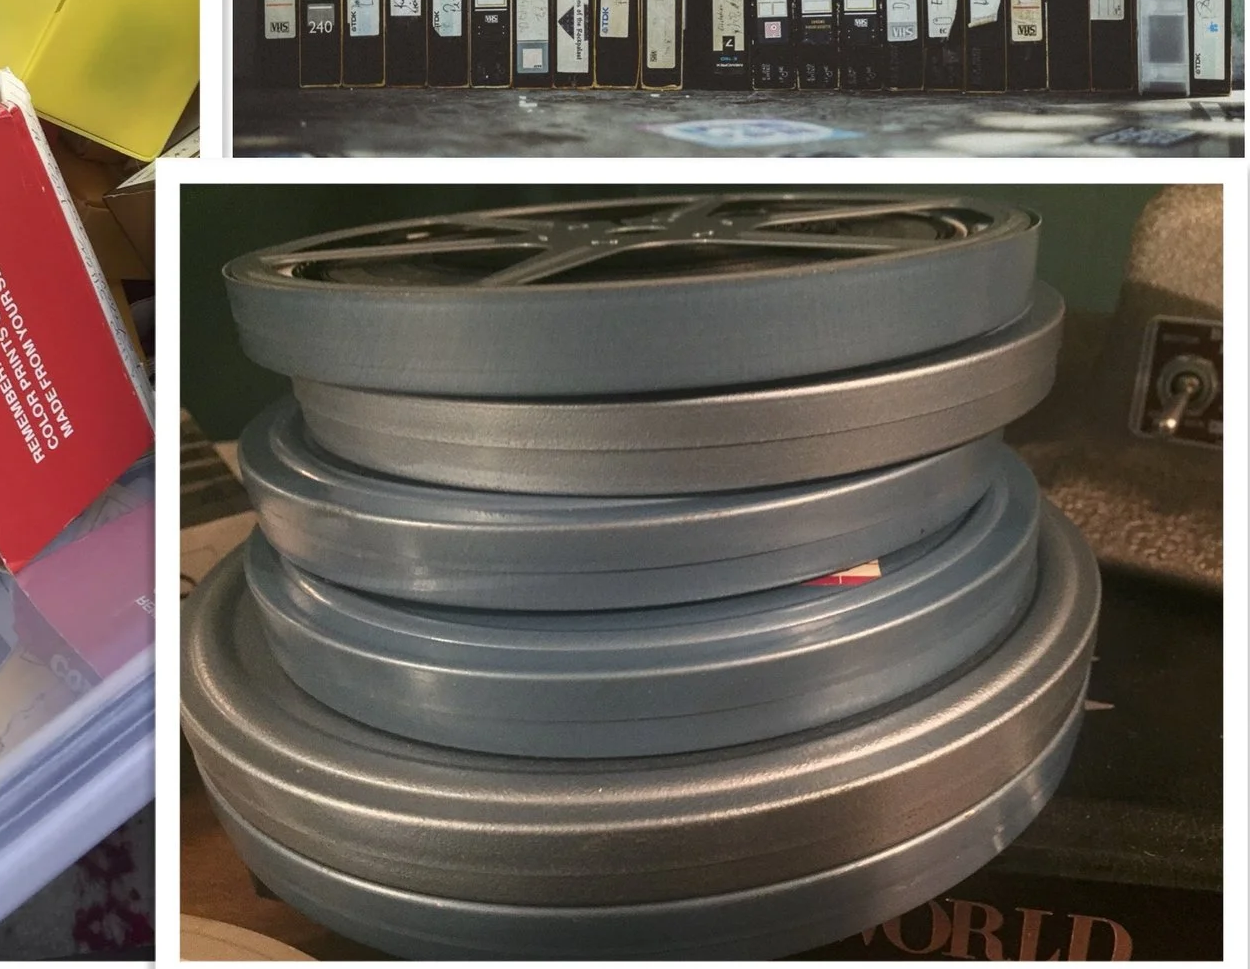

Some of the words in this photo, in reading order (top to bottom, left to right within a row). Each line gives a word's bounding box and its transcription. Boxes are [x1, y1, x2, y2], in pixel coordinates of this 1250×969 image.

[271, 22, 289, 33] VHS
[309, 21, 332, 34] 240
[892, 26, 913, 37] VHS
[1018, 25, 1037, 36] VHS
[0, 290, 28, 341] YOUR
[22, 339, 52, 390] FROM
[26, 389, 59, 450] COLOR
[45, 387, 75, 439] MADE
[860, 898, 1133, 961] ORLD
